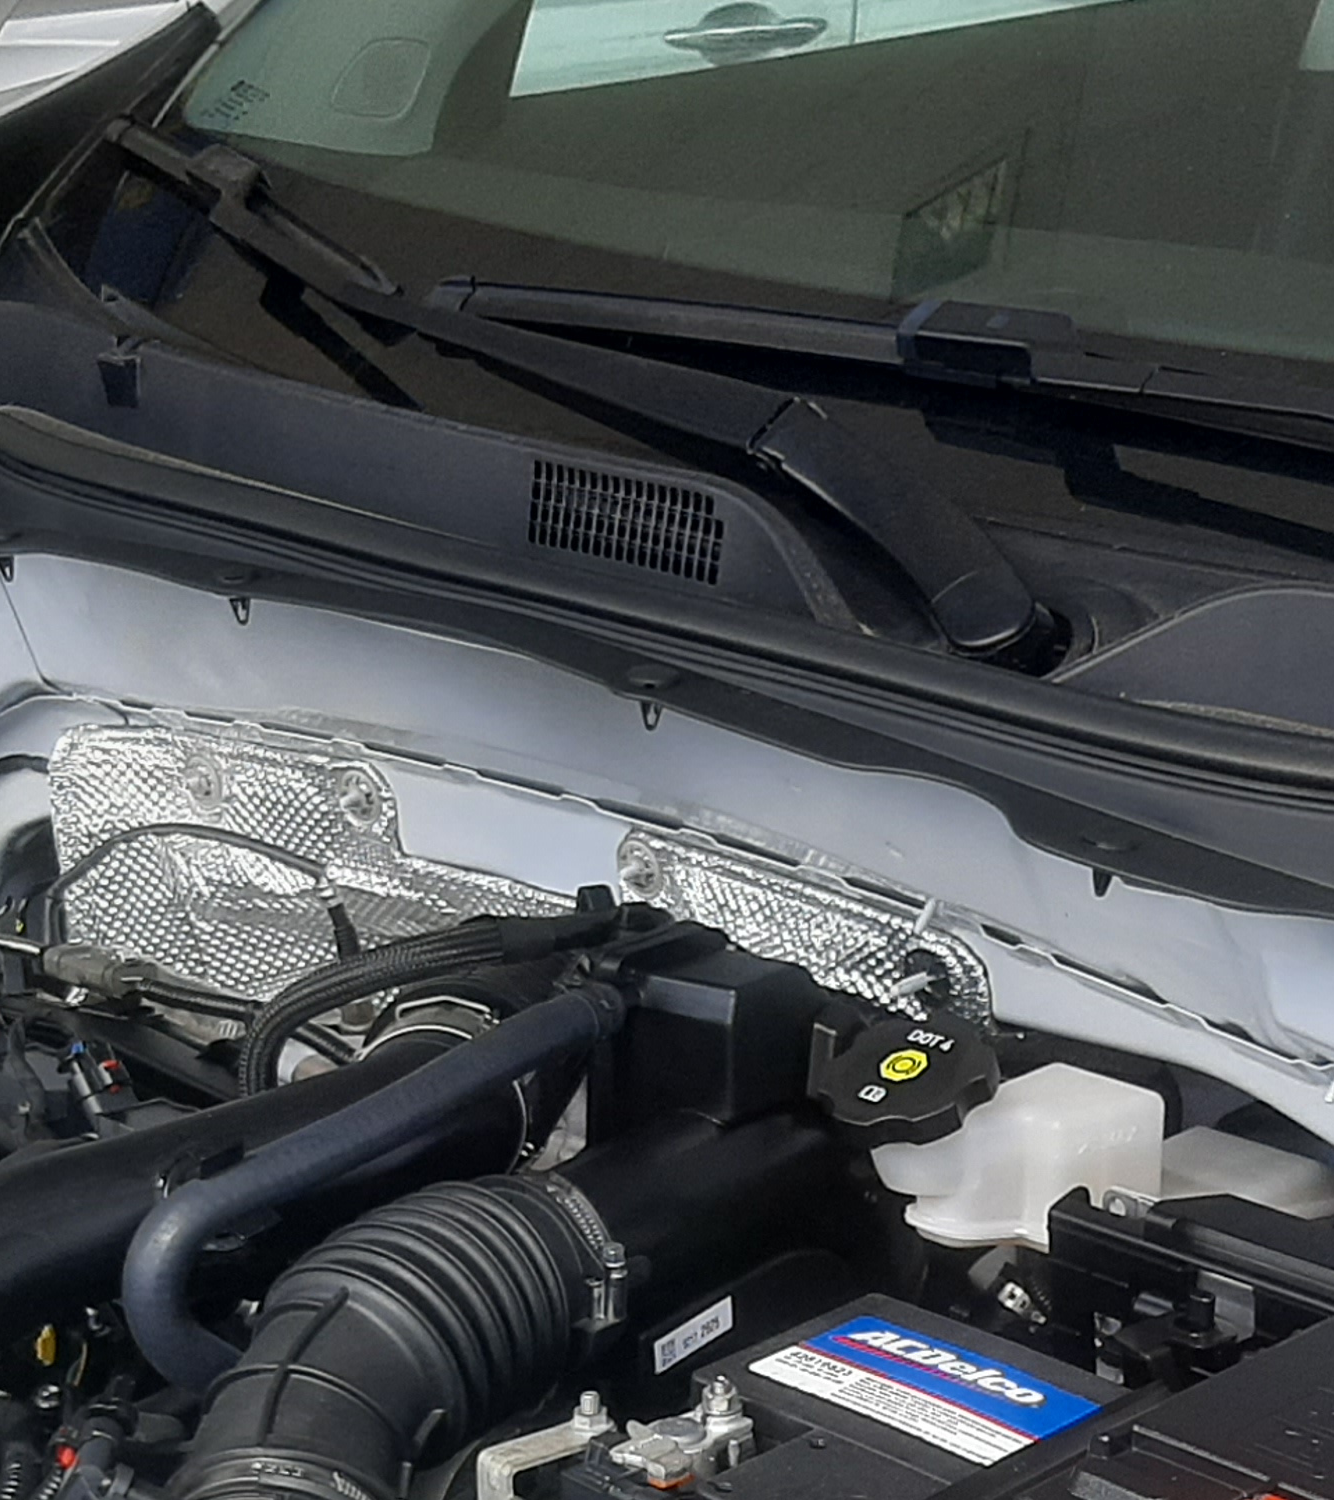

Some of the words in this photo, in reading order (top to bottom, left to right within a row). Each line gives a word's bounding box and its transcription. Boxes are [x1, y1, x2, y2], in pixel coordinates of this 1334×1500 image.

[907, 1029, 942, 1048] DOT
[939, 1039, 955, 1053] 4
[847, 1328, 1048, 1408] ACDelco
